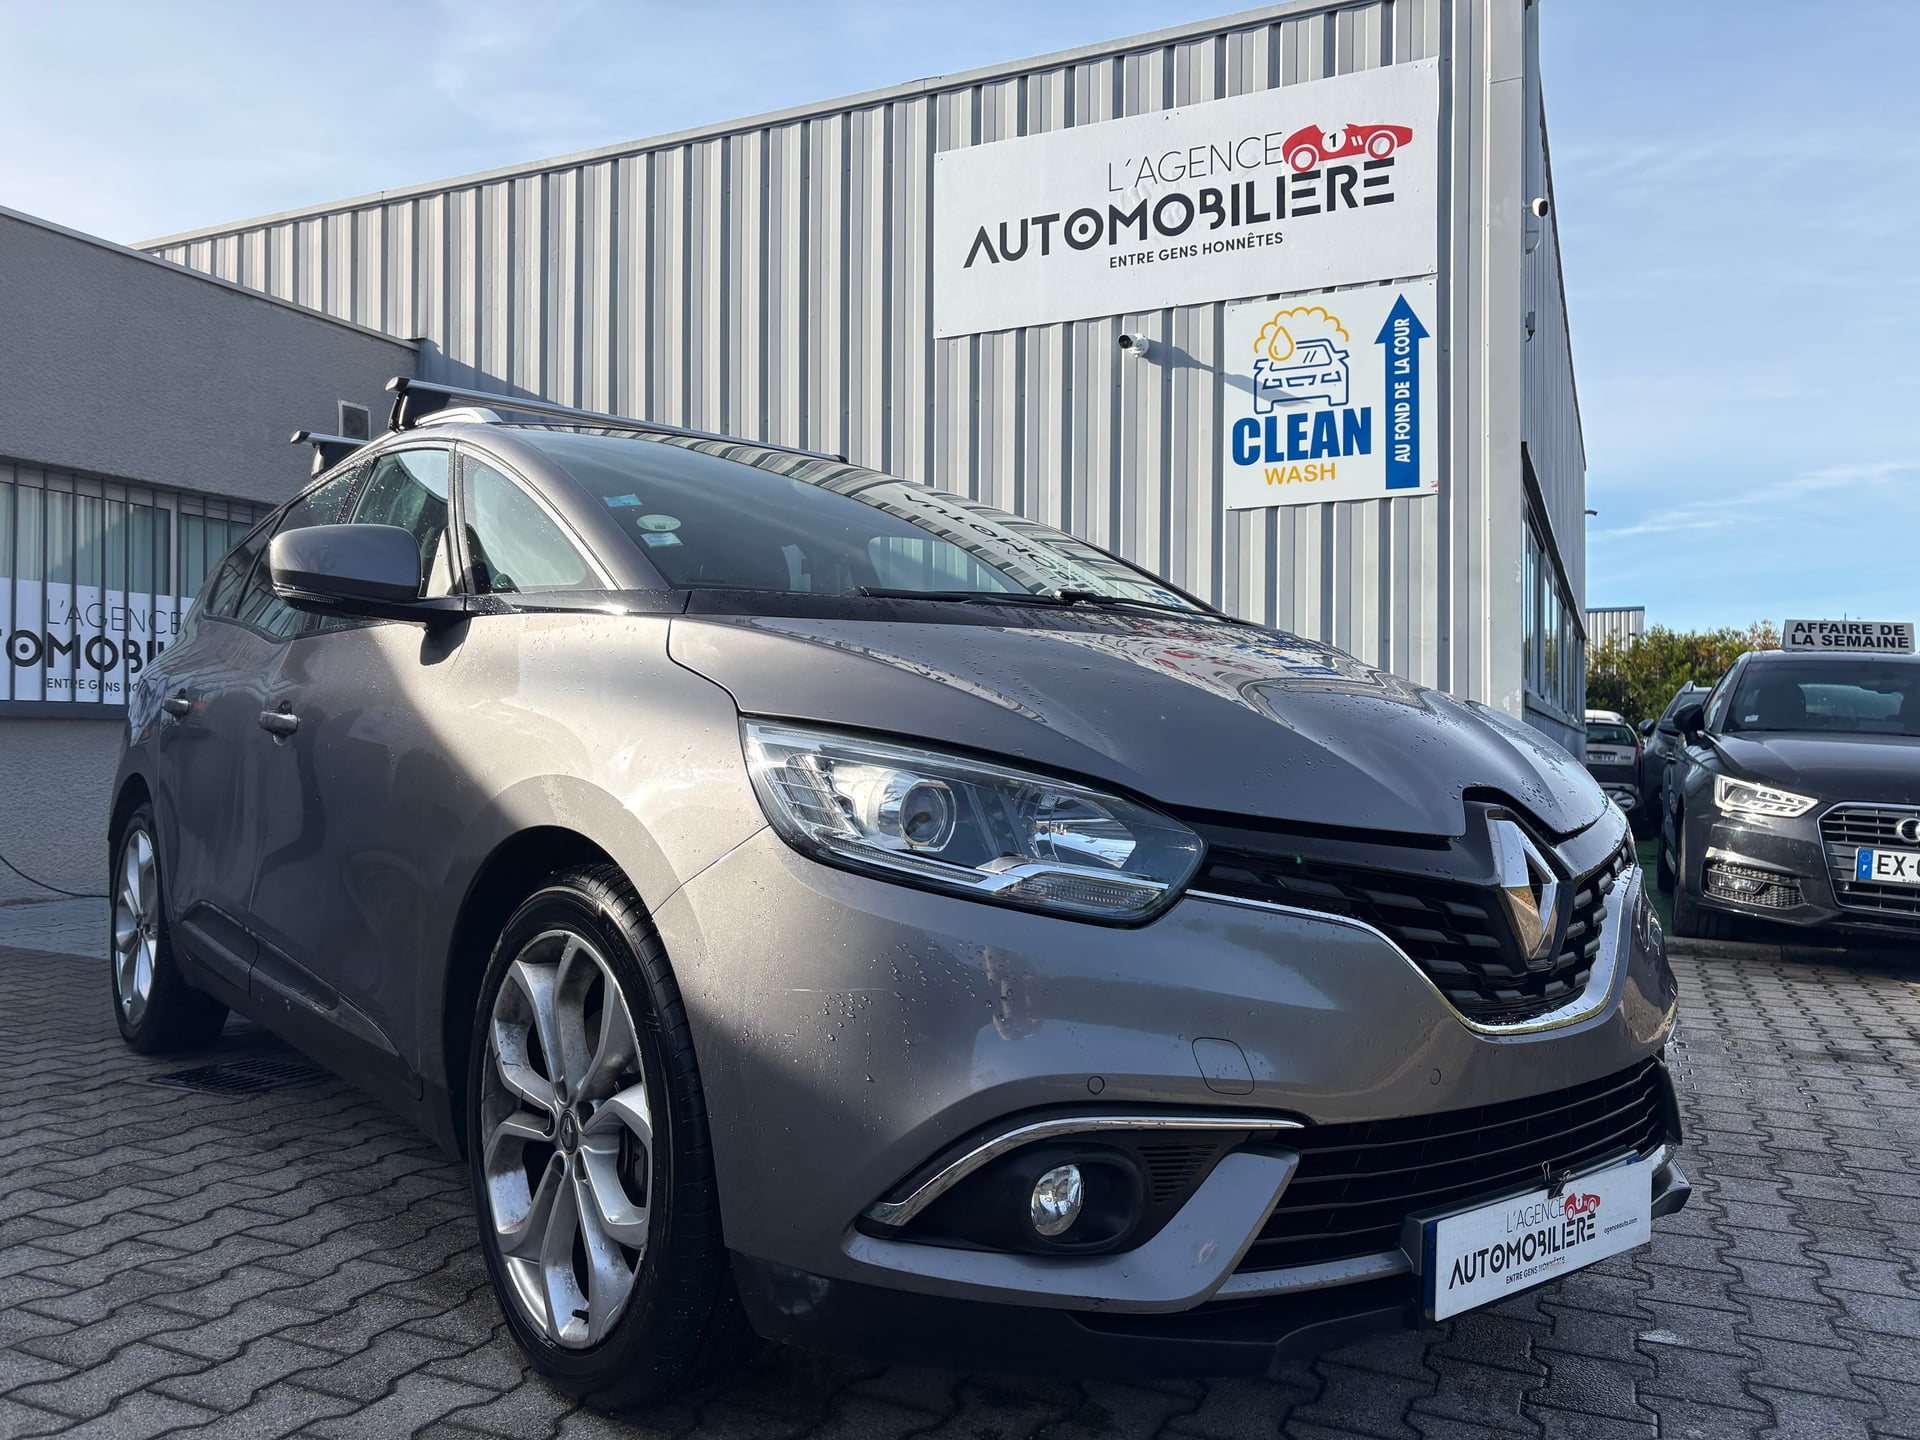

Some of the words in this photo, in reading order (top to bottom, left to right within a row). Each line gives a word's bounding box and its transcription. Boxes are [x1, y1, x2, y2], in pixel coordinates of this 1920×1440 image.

[1329, 132, 1337, 148] 1
[1108, 131, 1283, 192] L'AGENCE
[963, 156, 1395, 269] AUTOMOBILIERE
[1109, 250, 1155, 269] ENTRE
[1158, 244, 1198, 261] GENS
[1202, 231, 1284, 255] HONNÊTES
[1394, 317, 1411, 357] COUR
[1394, 357, 1411, 375] LA
[1394, 381, 1411, 400] DE
[1394, 402, 1411, 446] FOND
[1232, 406, 1372, 466] CLEAN
[1394, 447, 1411, 463] AU
[1264, 462, 1336, 486] WASH
[1793, 622, 1874, 635] AFFAIRE
[1880, 625, 1905, 636] DE
[1791, 634, 1815, 646] LA
[1821, 635, 1909, 649] SEMAINE
[47, 678, 85, 690] ENTE
[88, 680, 121, 693] GNS
[1448, 1213, 1596, 1290] AUTOMOBILIERE
[1506, 1270, 1523, 1285] ENTRE
[1523, 1265, 1538, 1278] GENS
